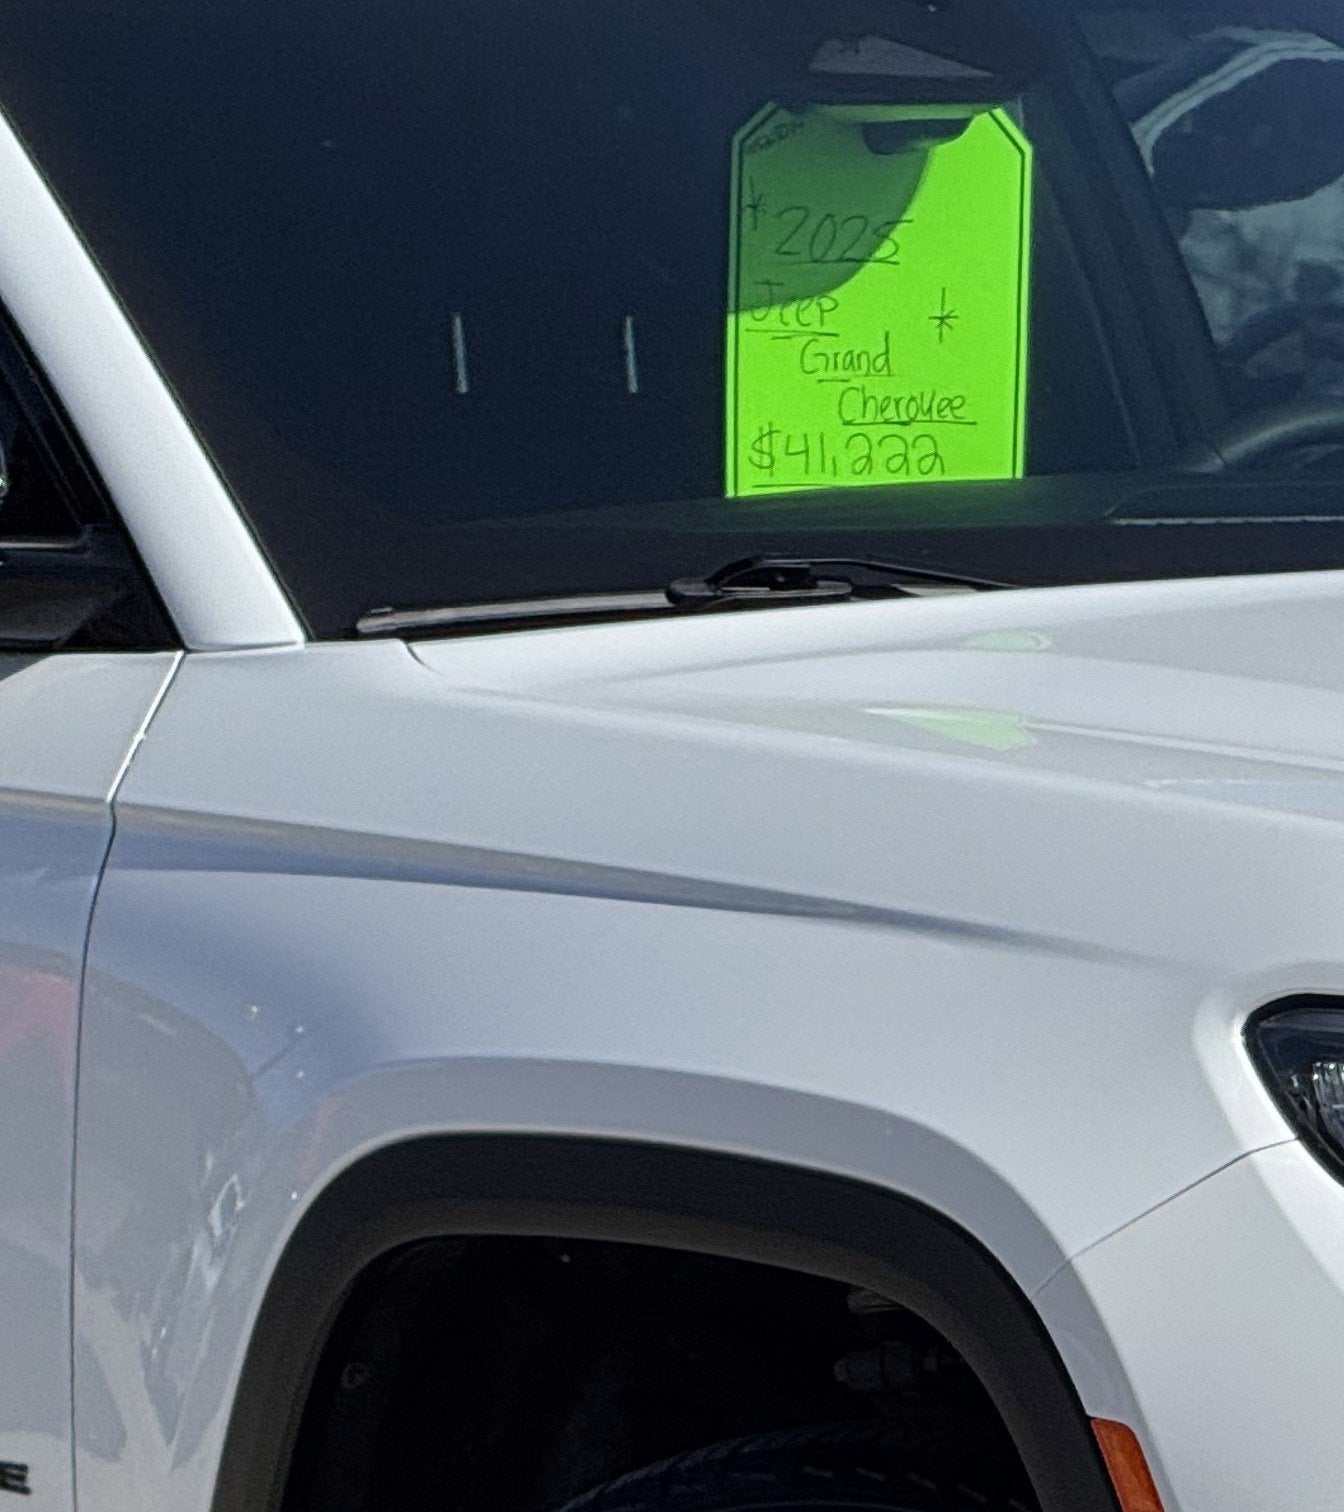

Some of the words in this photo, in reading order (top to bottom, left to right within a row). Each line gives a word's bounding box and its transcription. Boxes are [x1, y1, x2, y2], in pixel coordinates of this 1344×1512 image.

[775, 206, 913, 264] 2025
[801, 330, 892, 377] Grand
[748, 421, 945, 478] $41,222
